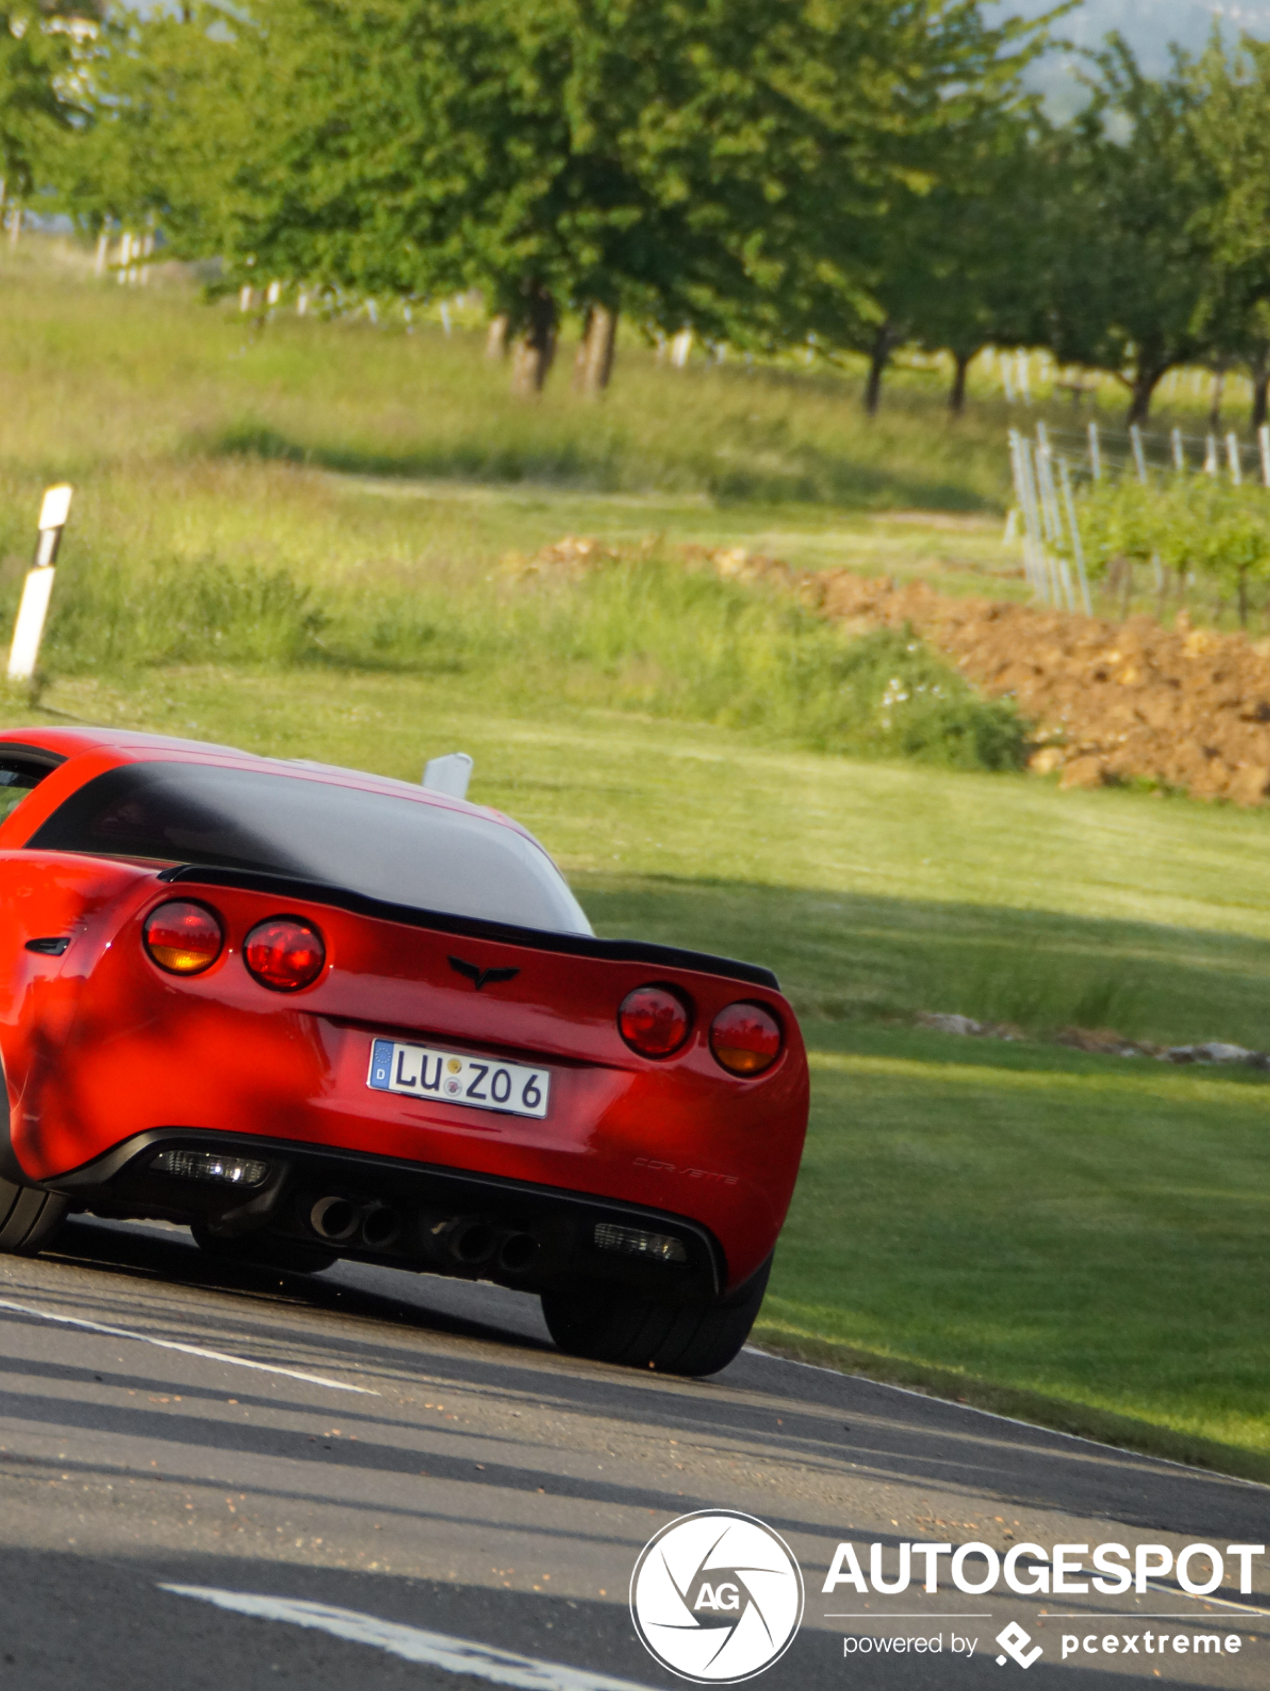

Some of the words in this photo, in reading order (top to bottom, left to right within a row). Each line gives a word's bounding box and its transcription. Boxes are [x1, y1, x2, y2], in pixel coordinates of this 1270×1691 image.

[376, 1068, 386, 1080] D
[395, 1050, 443, 1092] LU
[466, 1063, 512, 1104] ZO
[521, 1074, 542, 1109] 6
